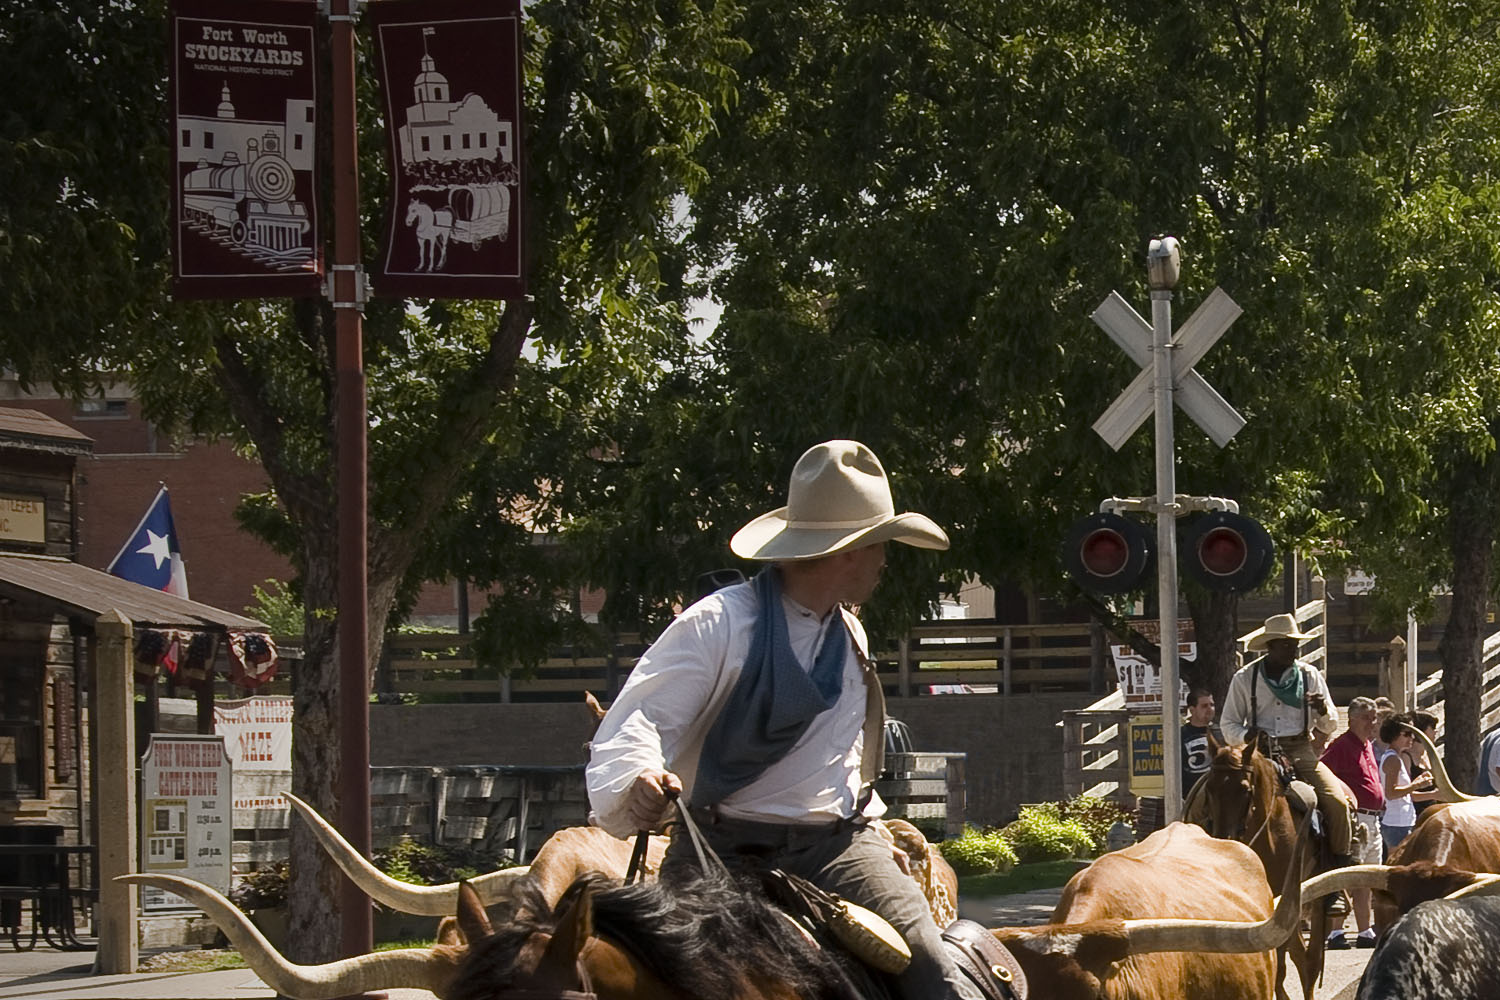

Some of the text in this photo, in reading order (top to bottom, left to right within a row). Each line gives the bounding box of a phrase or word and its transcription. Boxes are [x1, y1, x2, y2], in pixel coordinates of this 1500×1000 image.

[202, 26, 288, 45] Fort Worth
[185, 43, 303, 66] STOCKYARDS
[194, 63, 294, 76] NATIONAL HISTORIC DISTRICT
[1134, 729, 1154, 741] PAY
[160, 771, 217, 796] CATTLE DRIVE
